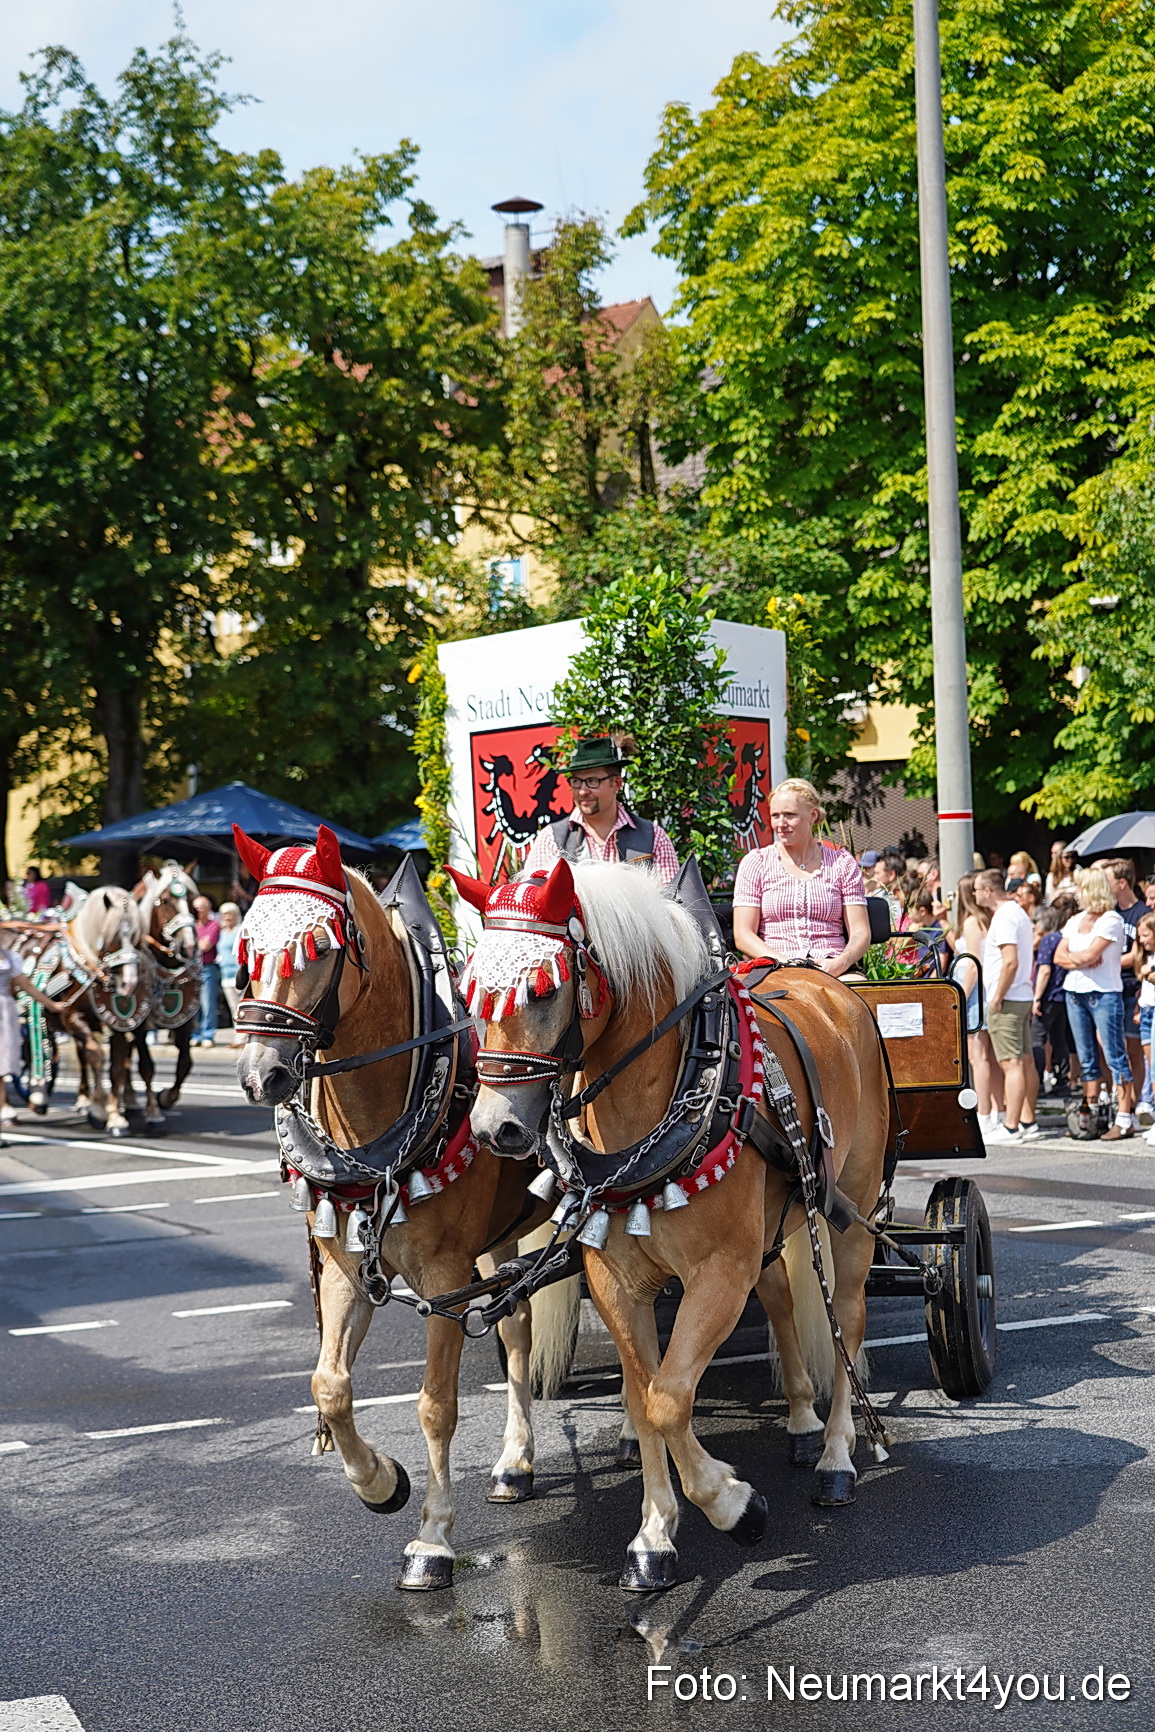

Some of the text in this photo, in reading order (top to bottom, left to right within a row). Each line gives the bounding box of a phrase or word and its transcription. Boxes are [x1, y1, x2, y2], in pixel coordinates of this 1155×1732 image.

[466, 685, 557, 723] Stadt Neu
[727, 679, 770, 709] umarkt
